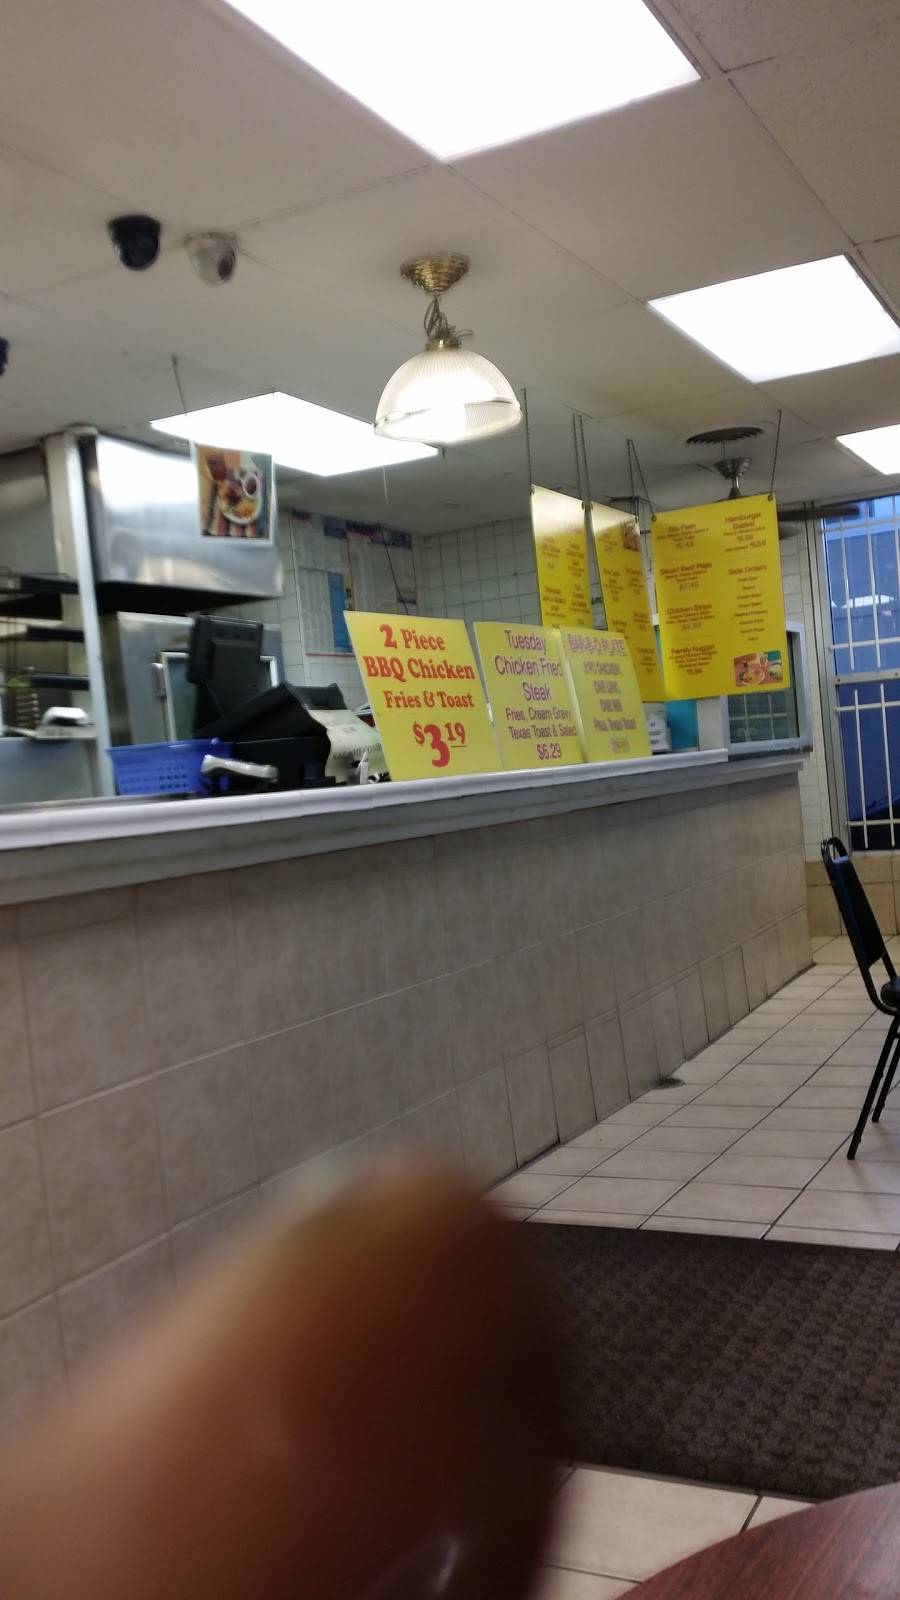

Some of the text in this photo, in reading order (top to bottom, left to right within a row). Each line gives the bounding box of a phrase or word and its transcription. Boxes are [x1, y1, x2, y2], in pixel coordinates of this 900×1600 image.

[379, 623, 445, 650] 2 Piece
[504, 630, 547, 655] Tuesday
[363, 655, 476, 682] BBQ Chicken
[494, 655, 540, 676] Chicken
[383, 690, 475, 709] Fries & Toast
[522, 681, 552, 701] Steak
[528, 706, 552, 721] Cream
[508, 725, 532, 739] Texas
[531, 724, 552, 738] Toast
[536, 742, 562, 760] $6.29
